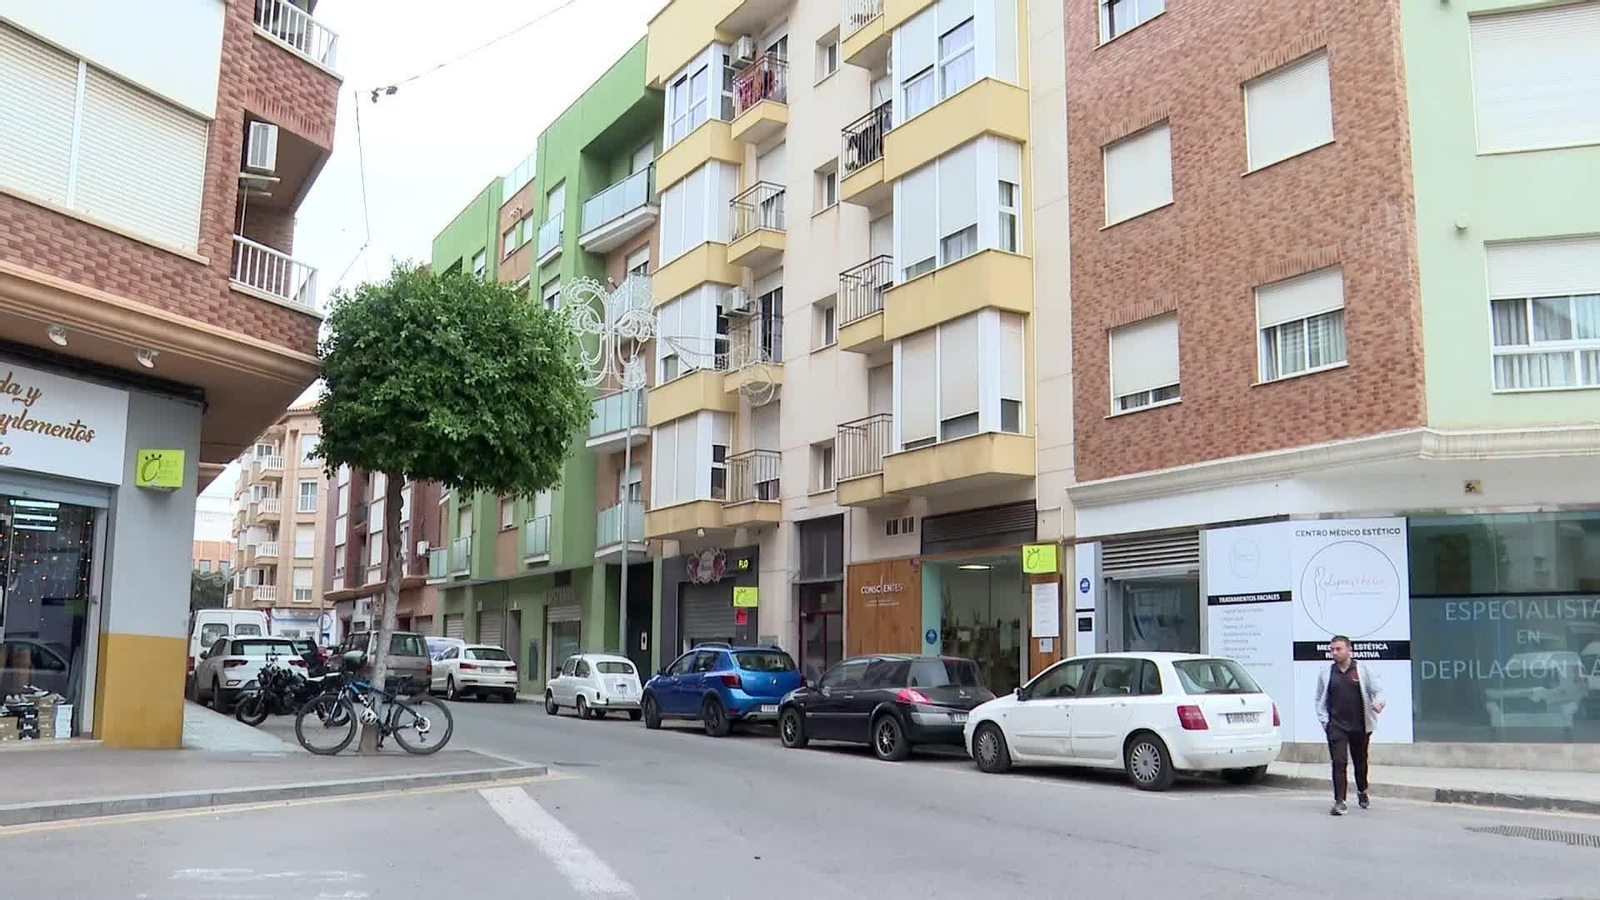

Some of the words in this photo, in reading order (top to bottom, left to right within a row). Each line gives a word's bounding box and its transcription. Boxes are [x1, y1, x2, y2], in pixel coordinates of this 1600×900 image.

[12, 386, 42, 407] y
[1294, 529, 1328, 537] CENTRO
[1329, 527, 1360, 537] MÉDICO
[1362, 526, 1401, 536] ESTÉTICO
[1517, 629, 1541, 644] EN
[1353, 642, 1388, 651] ESTÉTICA
